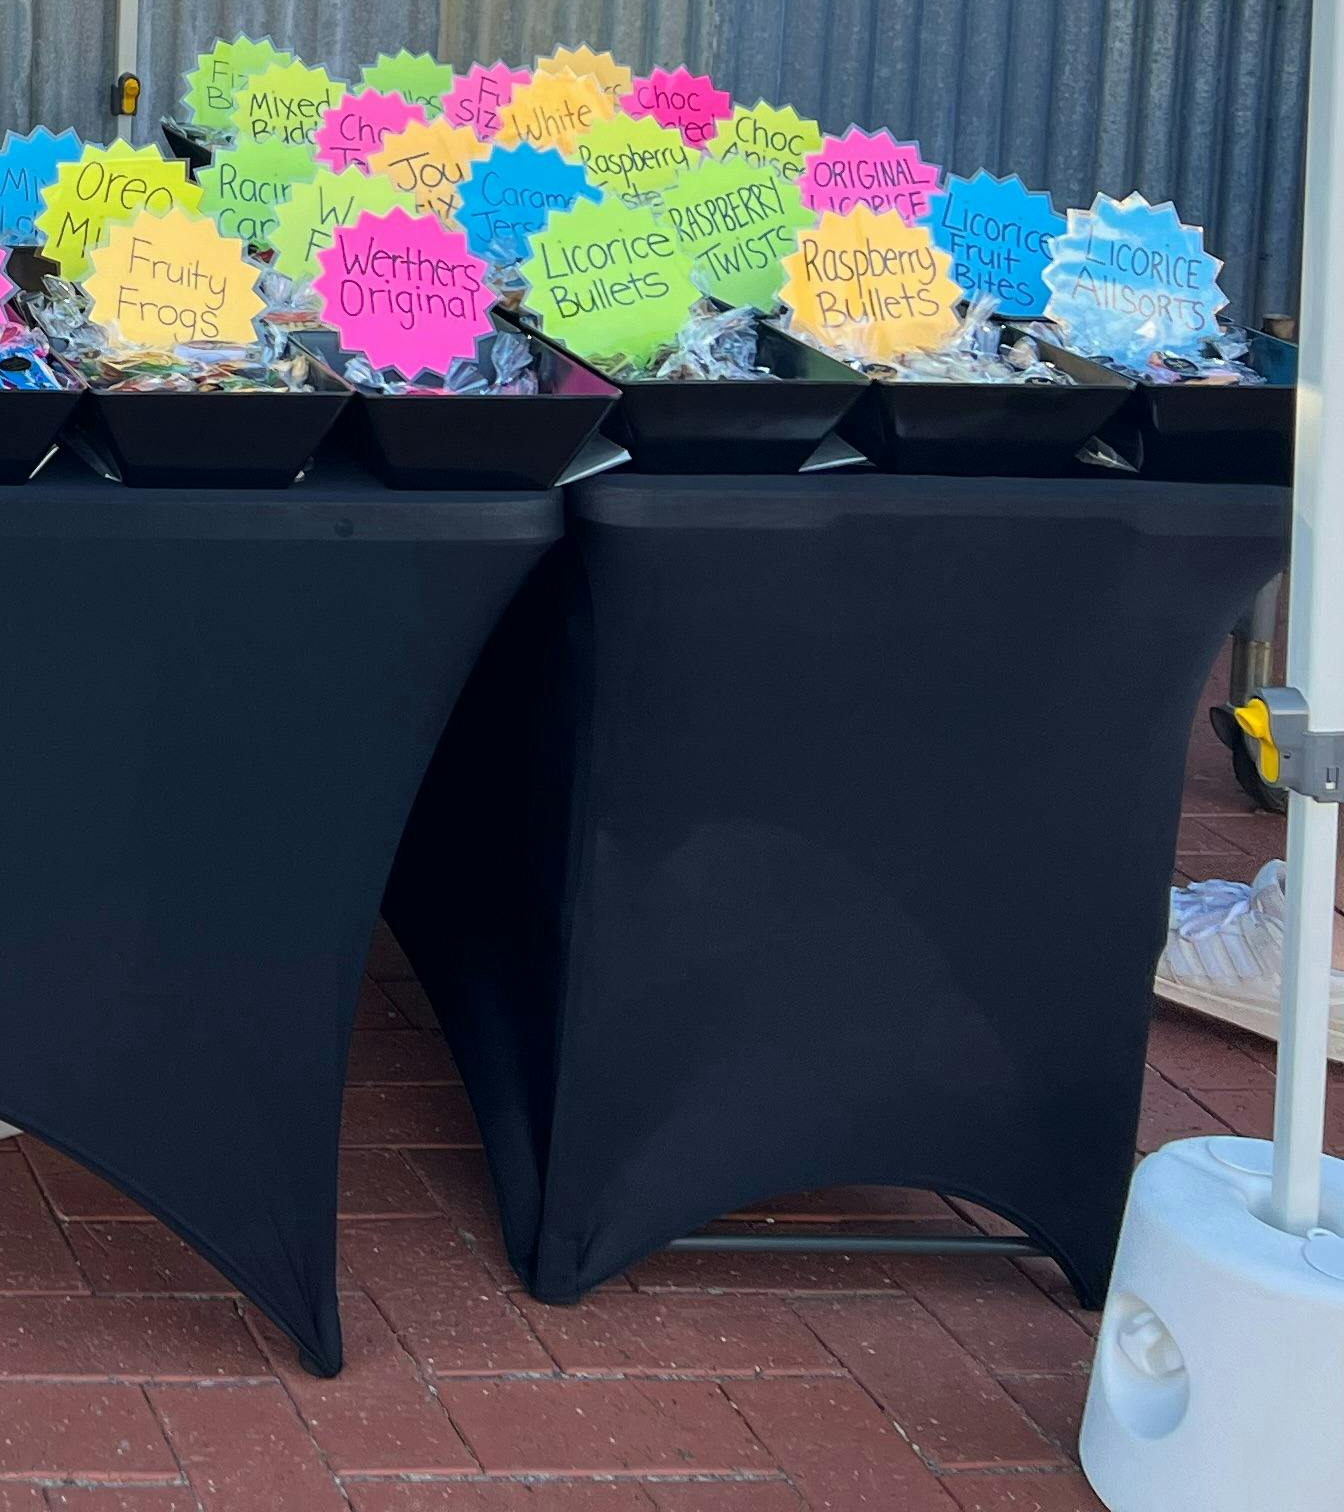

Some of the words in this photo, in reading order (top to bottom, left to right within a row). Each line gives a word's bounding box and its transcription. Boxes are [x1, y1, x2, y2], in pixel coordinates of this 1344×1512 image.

[250, 88, 332, 120] Mixed
[512, 100, 593, 142] White
[637, 85, 701, 112] Choc
[735, 116, 805, 156] Choc
[76, 160, 174, 211] Oreo
[578, 143, 690, 189] Raspberry
[813, 159, 931, 189] ORIGINAL
[669, 177, 785, 243] RASPBERRY
[941, 192, 1054, 260] Licorice
[129, 236, 227, 311] Fruity
[339, 234, 481, 293] Werthers
[542, 233, 674, 281] Licorice
[803, 238, 937, 285] Raspberry
[951, 233, 1021, 274] Fruit
[1085, 226, 1203, 290] LICORICE
[340, 278, 478, 330] Original
[550, 272, 670, 319] Bullets
[816, 283, 940, 329] Bullets
[954, 263, 1035, 307] Bites
[117, 285, 220, 341] Frogs
